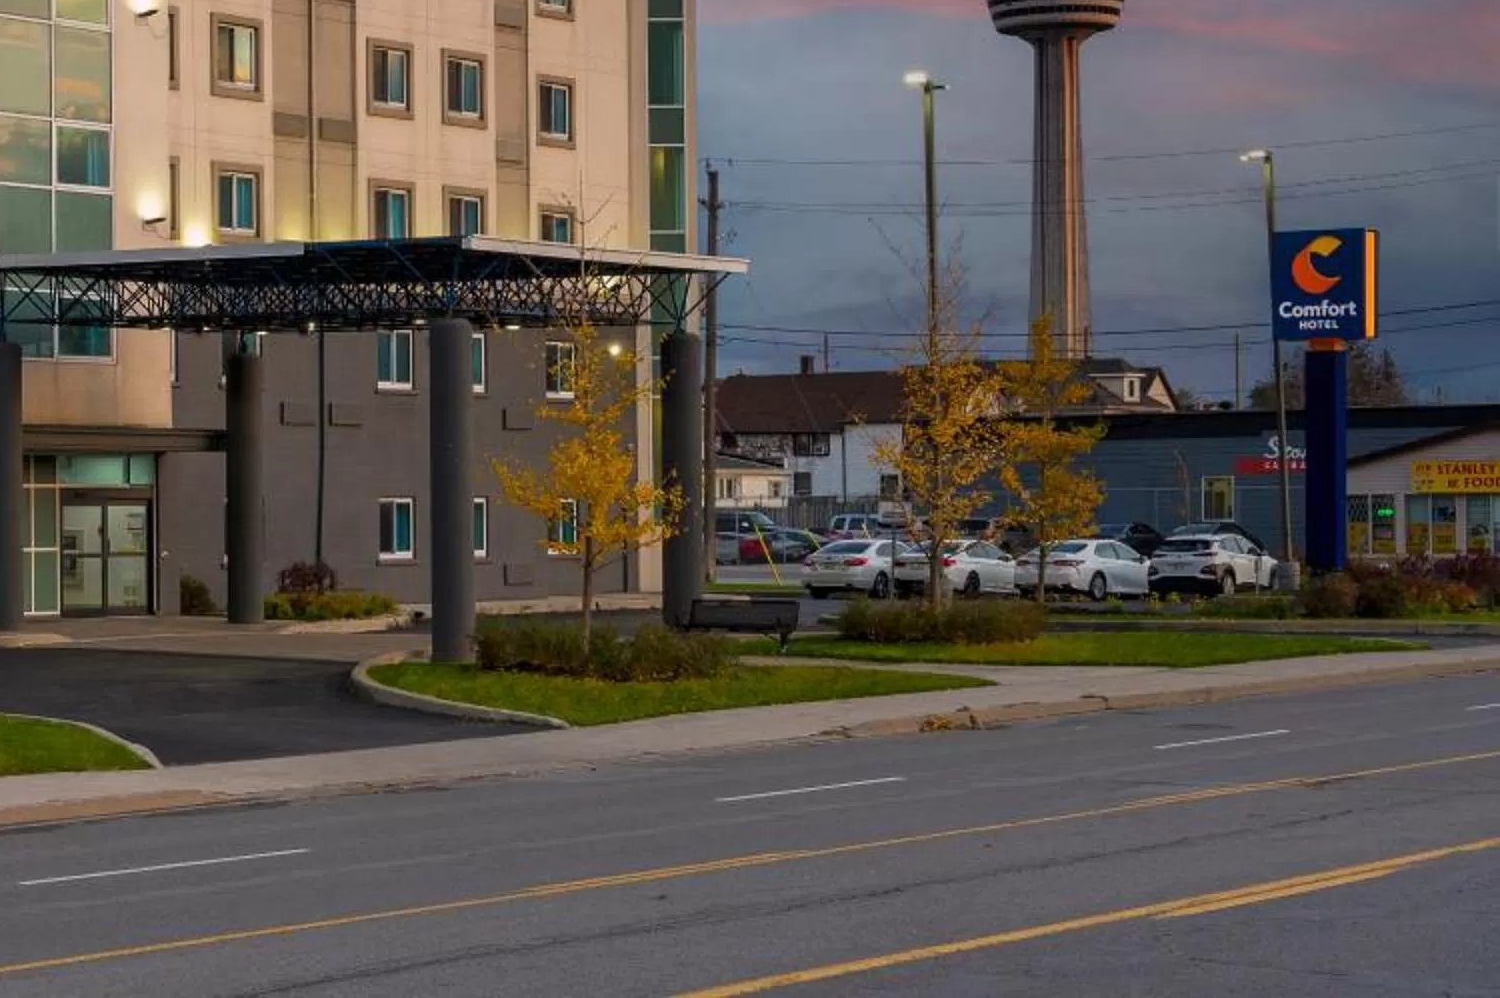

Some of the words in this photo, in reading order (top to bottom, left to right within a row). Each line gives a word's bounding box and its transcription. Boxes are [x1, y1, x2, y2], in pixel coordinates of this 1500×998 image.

[1279, 300, 1357, 318] Comfort
[1299, 320, 1339, 330] HOTEL
[1437, 463, 1495, 475] STANLEY
